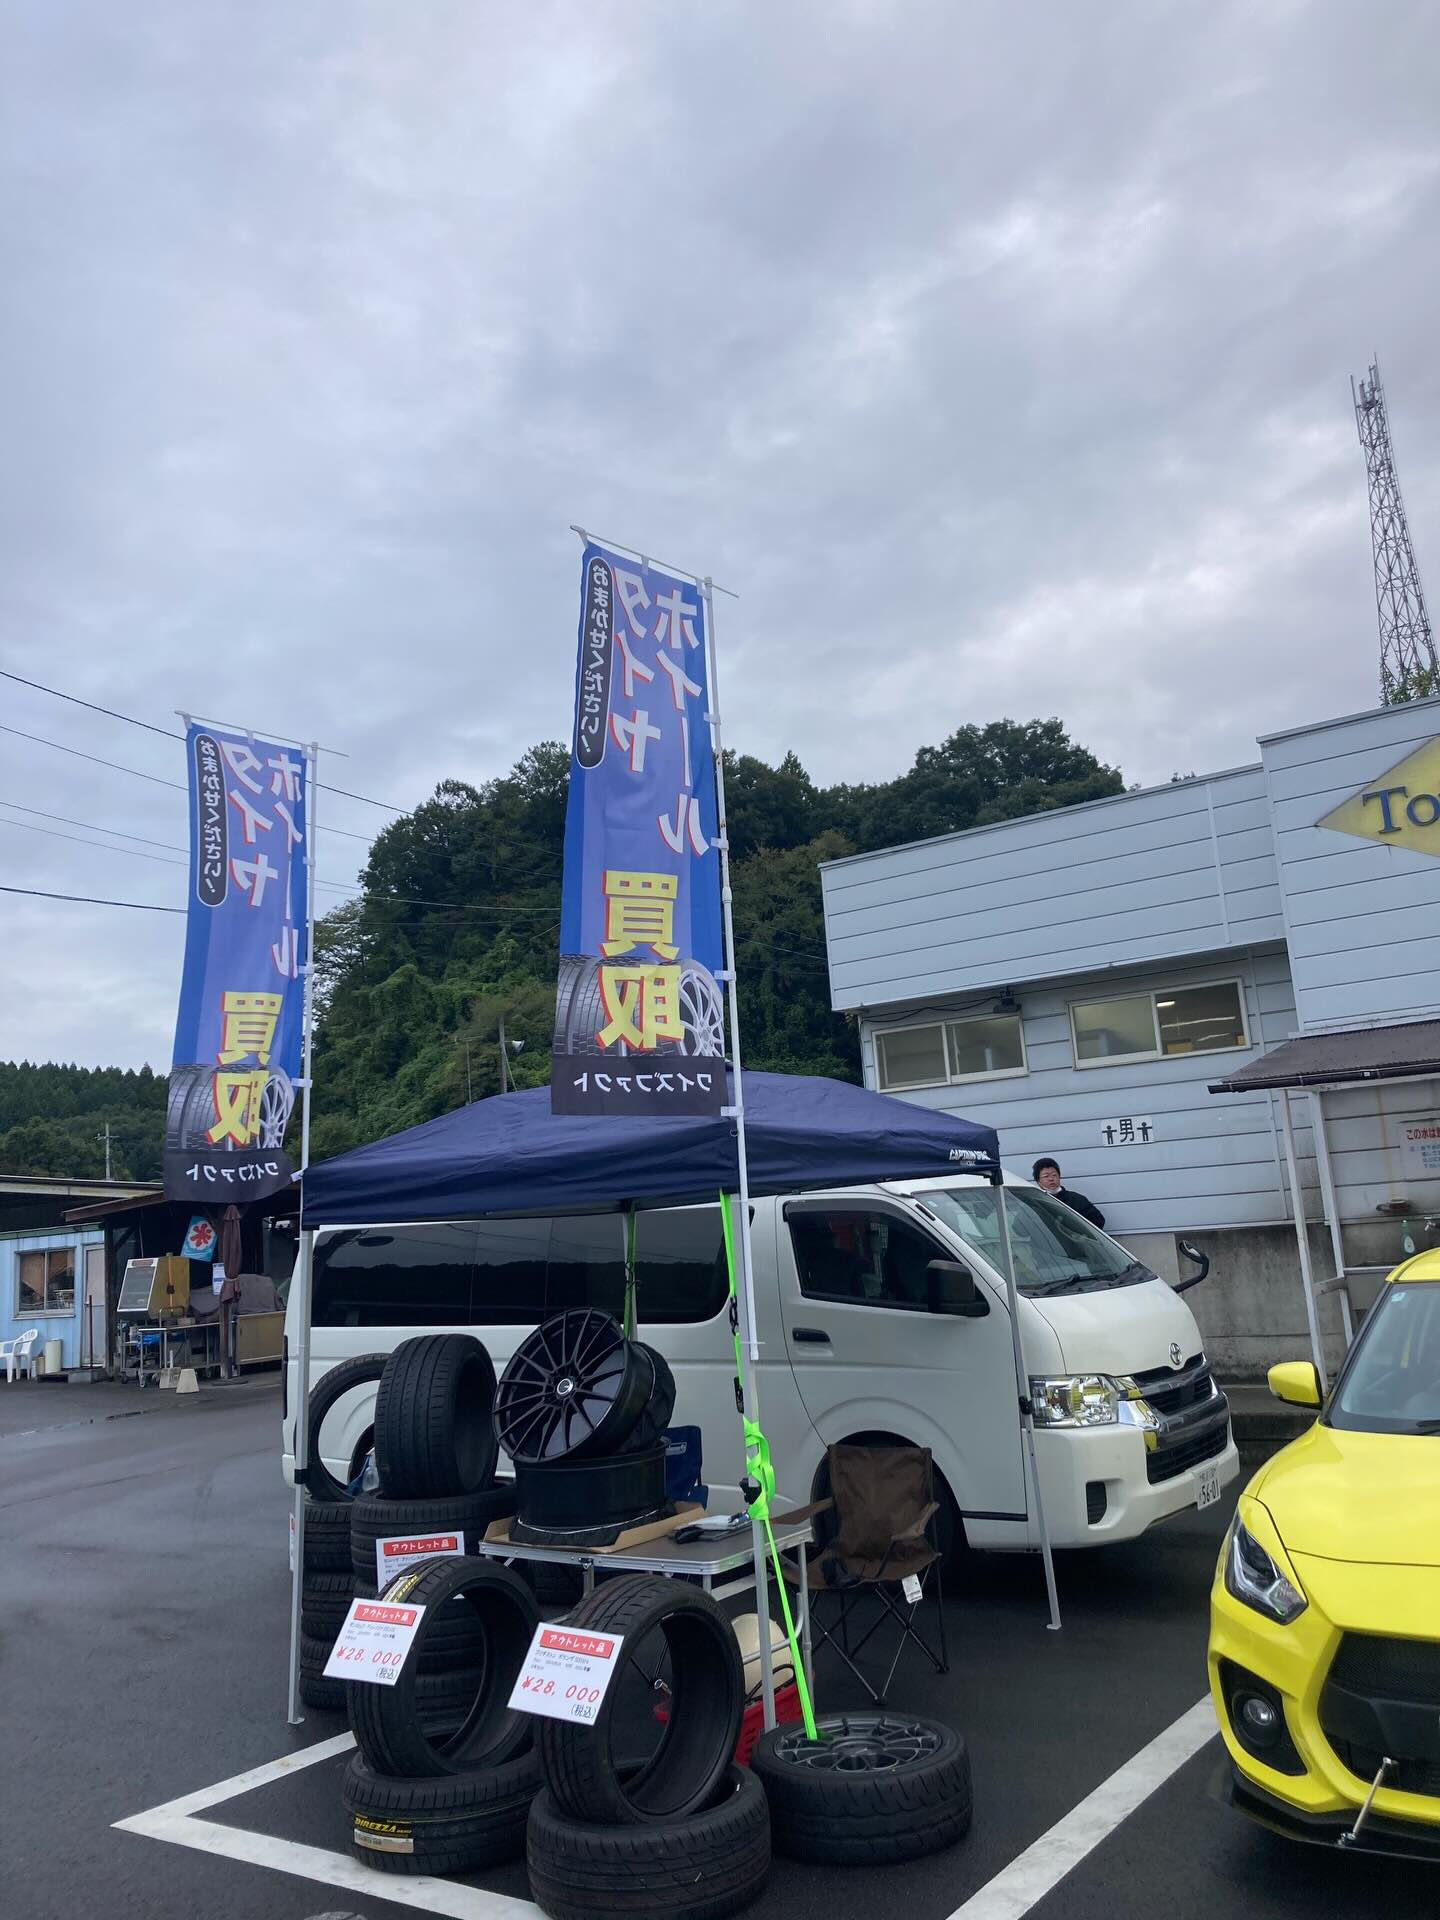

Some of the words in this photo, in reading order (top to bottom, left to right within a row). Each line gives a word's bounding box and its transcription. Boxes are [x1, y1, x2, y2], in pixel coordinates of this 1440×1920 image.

[1361, 787, 1440, 835] To
[1119, 1118, 1135, 1143] 男
[391, 1539, 449, 1552] アウトレット品
[361, 1607, 409, 1622] アウトレット品
[548, 1634, 606, 1653] アウトレット品
[570, 1703, 597, 1719] (税込)
[354, 1816, 397, 1833] DIREZZA
